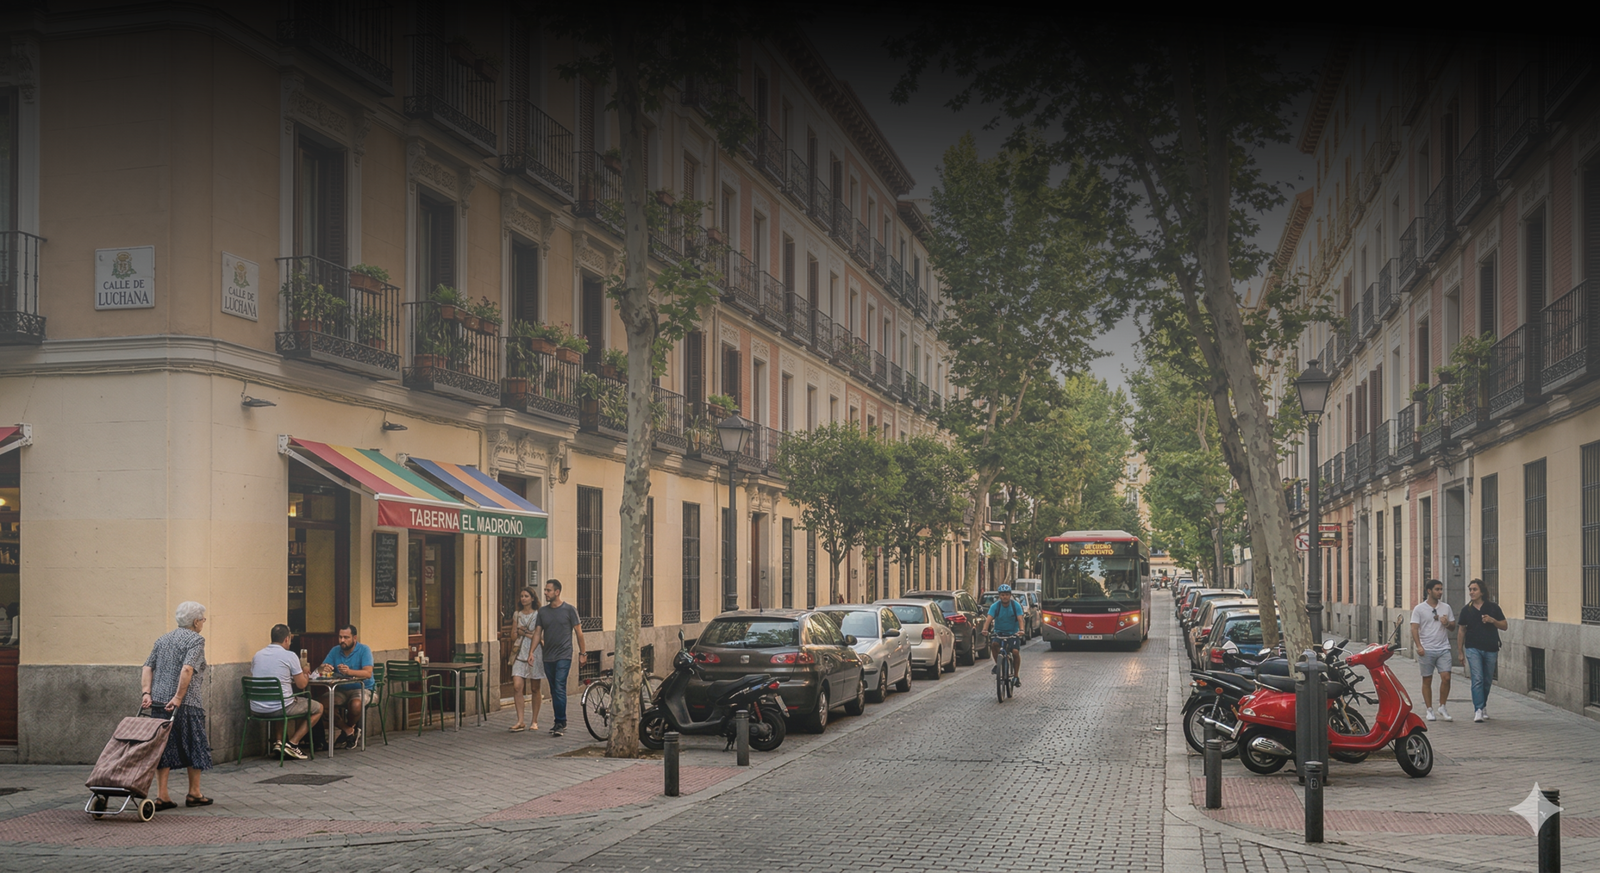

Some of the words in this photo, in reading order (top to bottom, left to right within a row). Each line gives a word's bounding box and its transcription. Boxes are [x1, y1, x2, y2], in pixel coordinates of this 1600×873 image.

[103, 280, 131, 290] CALLE
[133, 279, 145, 289] DE
[98, 291, 150, 306] LUCHANA
[228, 286, 246, 299] CALLE
[247, 291, 255, 302] DE
[224, 295, 258, 318] LUCHANA
[409, 508, 460, 530] TABERNA
[462, 514, 475, 531] EL
[477, 516, 523, 535] MADROÑO
[1060, 544, 1070, 555] 16
